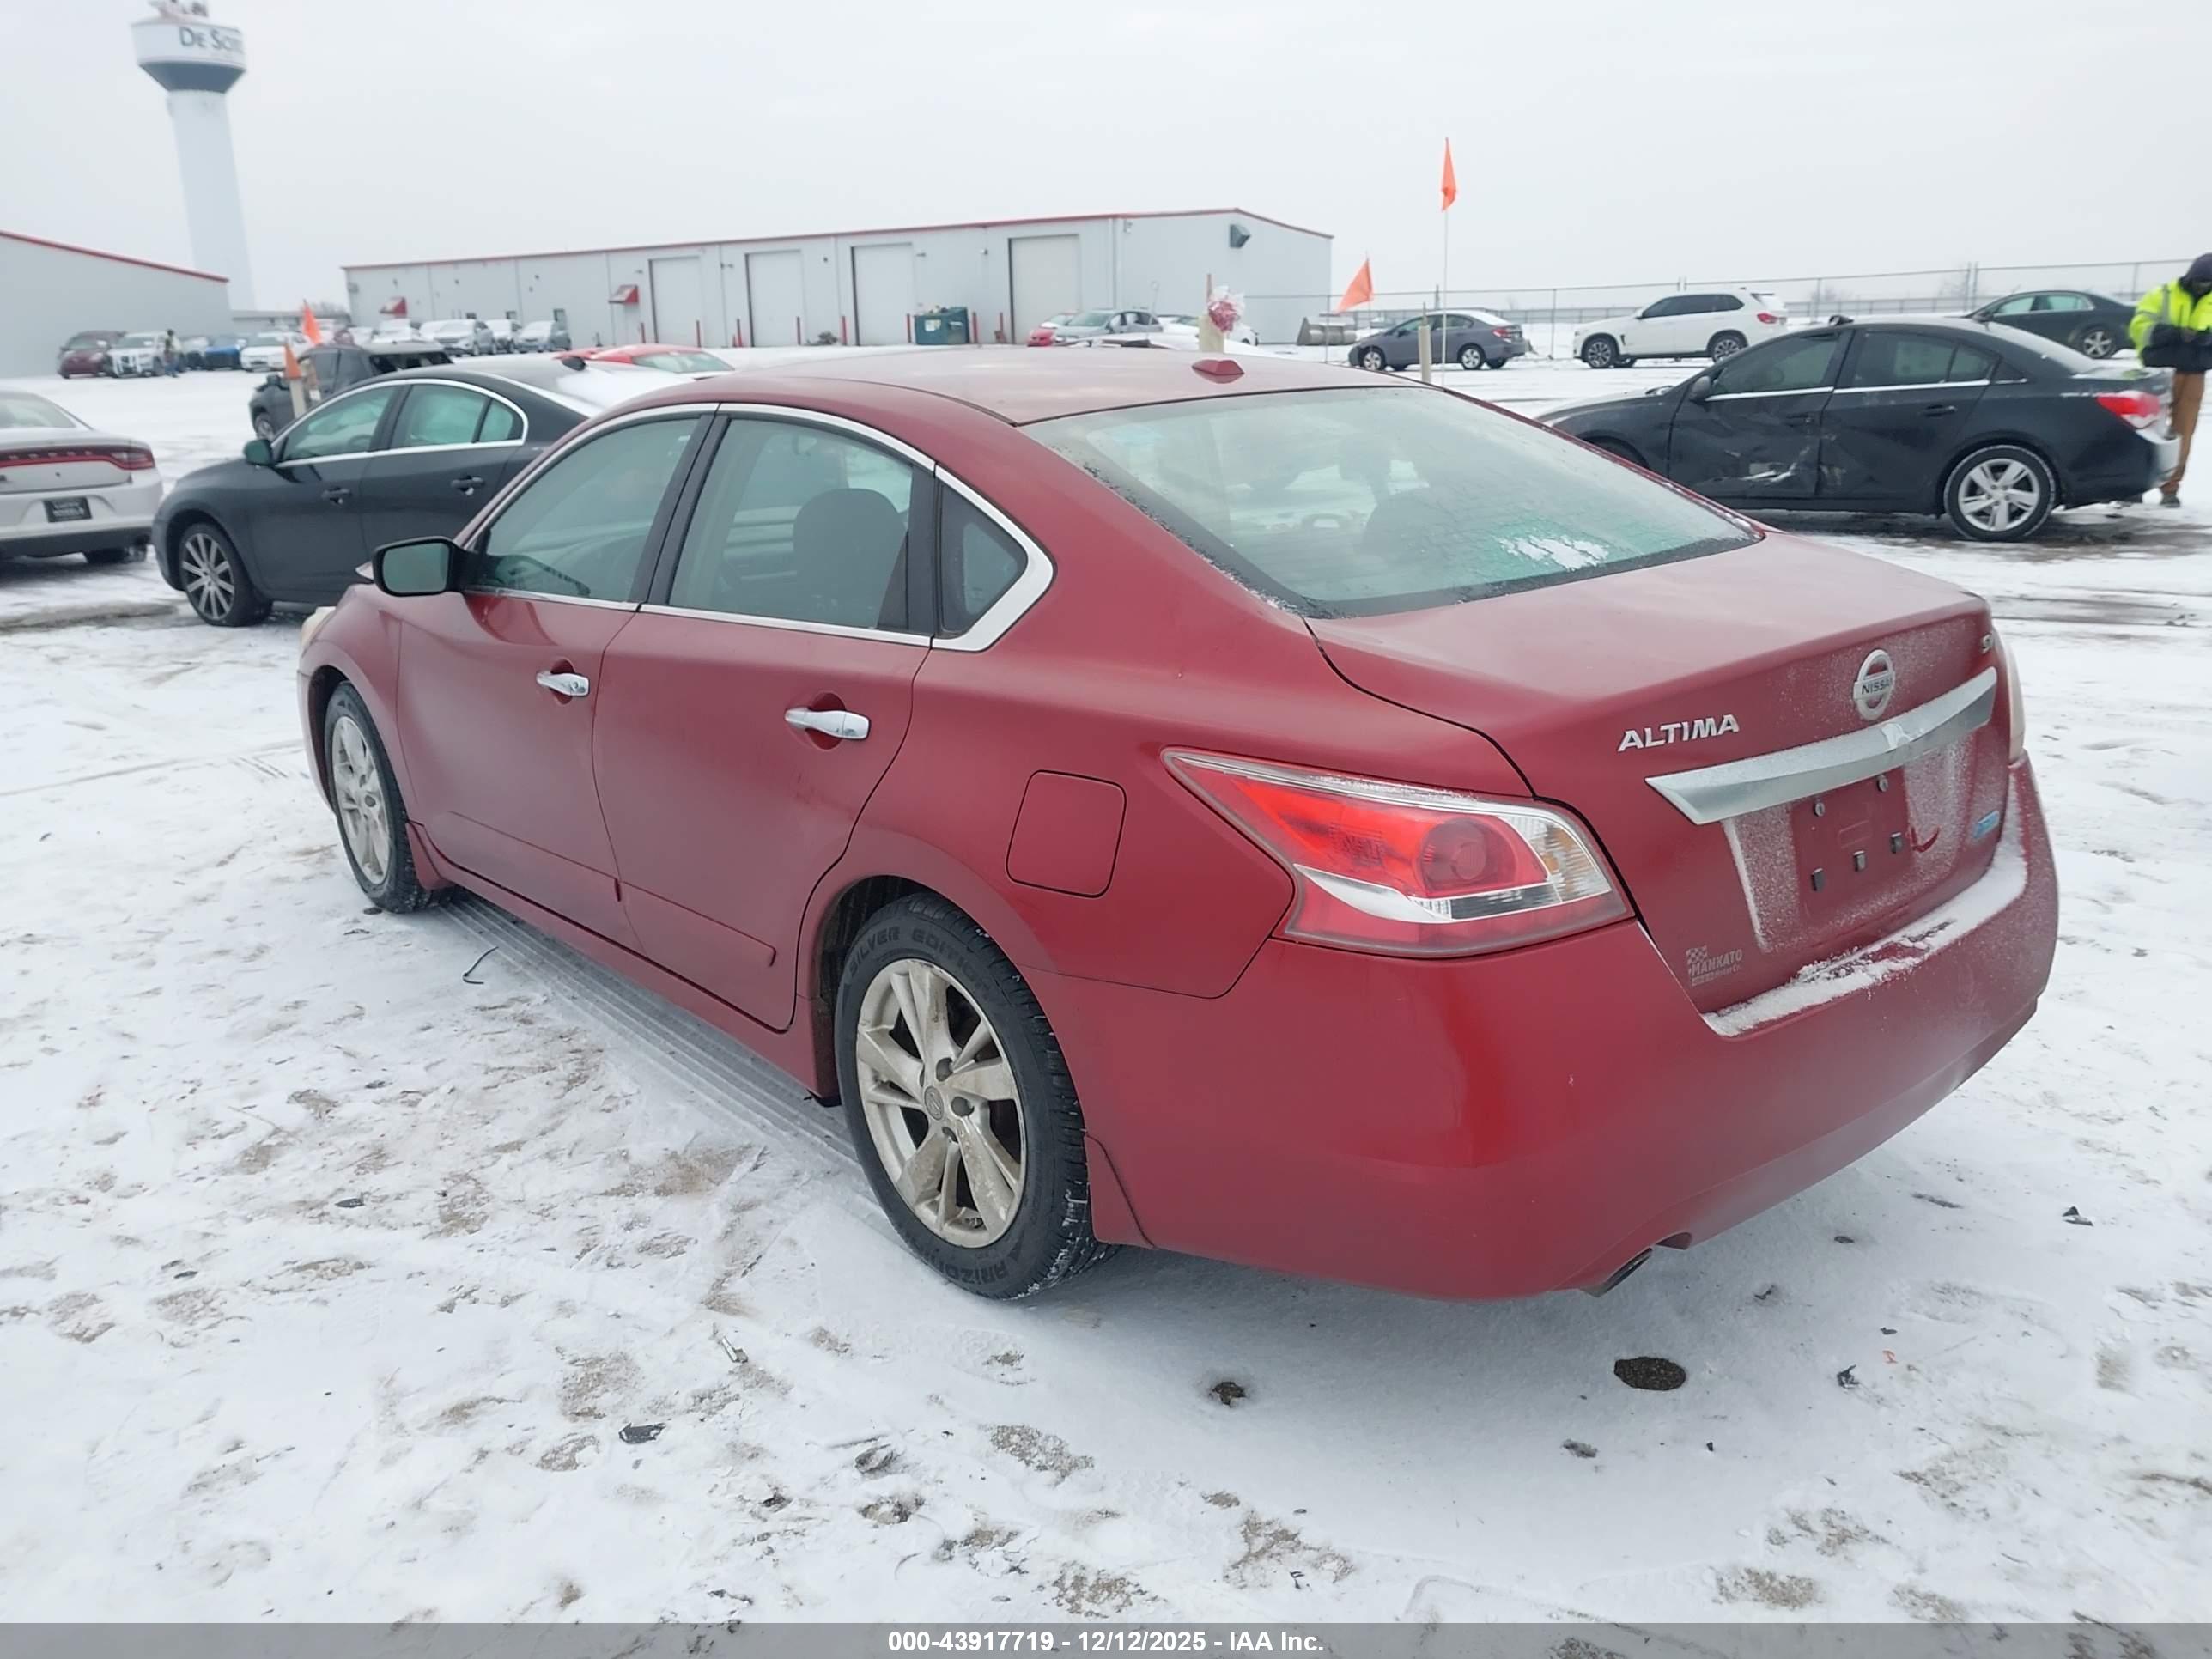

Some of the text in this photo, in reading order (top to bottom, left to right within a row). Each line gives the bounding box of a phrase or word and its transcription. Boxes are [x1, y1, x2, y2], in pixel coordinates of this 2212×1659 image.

[1617, 714, 1741, 752] ALTIMA
[848, 926, 901, 977] SILVER
[1690, 949, 1743, 976] MANKATO
